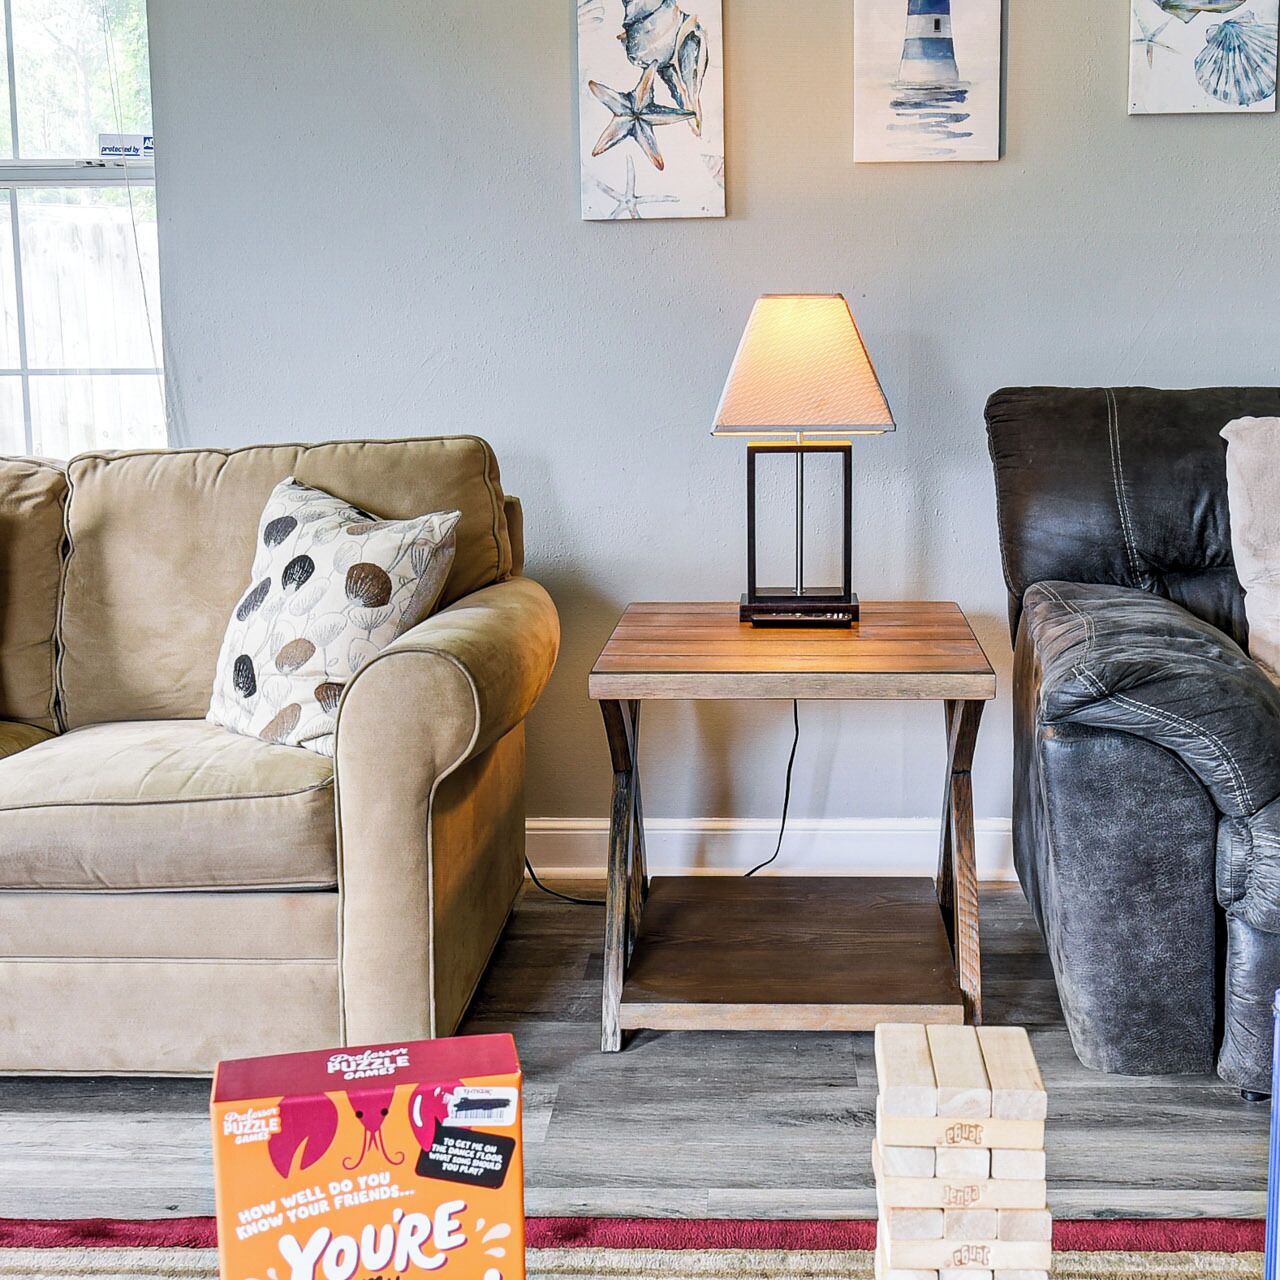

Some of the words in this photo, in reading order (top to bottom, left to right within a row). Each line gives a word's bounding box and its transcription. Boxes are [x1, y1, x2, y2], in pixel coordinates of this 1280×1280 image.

[101, 145, 132, 153] protected
[329, 1047, 408, 1063] Professor
[327, 1055, 410, 1074] PUZZLE
[344, 1066, 396, 1080] GAMES
[223, 1117, 280, 1136] PUZZLE
[945, 1123, 984, 1144] Jenga
[235, 1131, 269, 1145] GAMES
[443, 1138, 455, 1146] TO
[455, 1139, 471, 1149] GET
[471, 1142, 483, 1151] ME
[484, 1145, 497, 1153] ON
[432, 1143, 449, 1153] THE
[448, 1146, 475, 1158] DANCE
[428, 1152, 452, 1162] WHAT
[452, 1156, 471, 1165] SONG
[472, 1159, 502, 1170] SHOULD
[442, 1163, 459, 1172] YOU
[459, 1165, 484, 1176] PLAY?
[238, 1200, 277, 1224] HOW
[281, 1186, 326, 1208] WELL
[328, 1179, 353, 1195] DO
[357, 1171, 390, 1190] YOU
[943, 1185, 981, 1206] Jenga
[235, 1213, 283, 1241] KNOW
[286, 1199, 330, 1224] YOUR
[334, 1184, 416, 1210] FRIENDS...
[953, 1245, 991, 1266] Jenga
